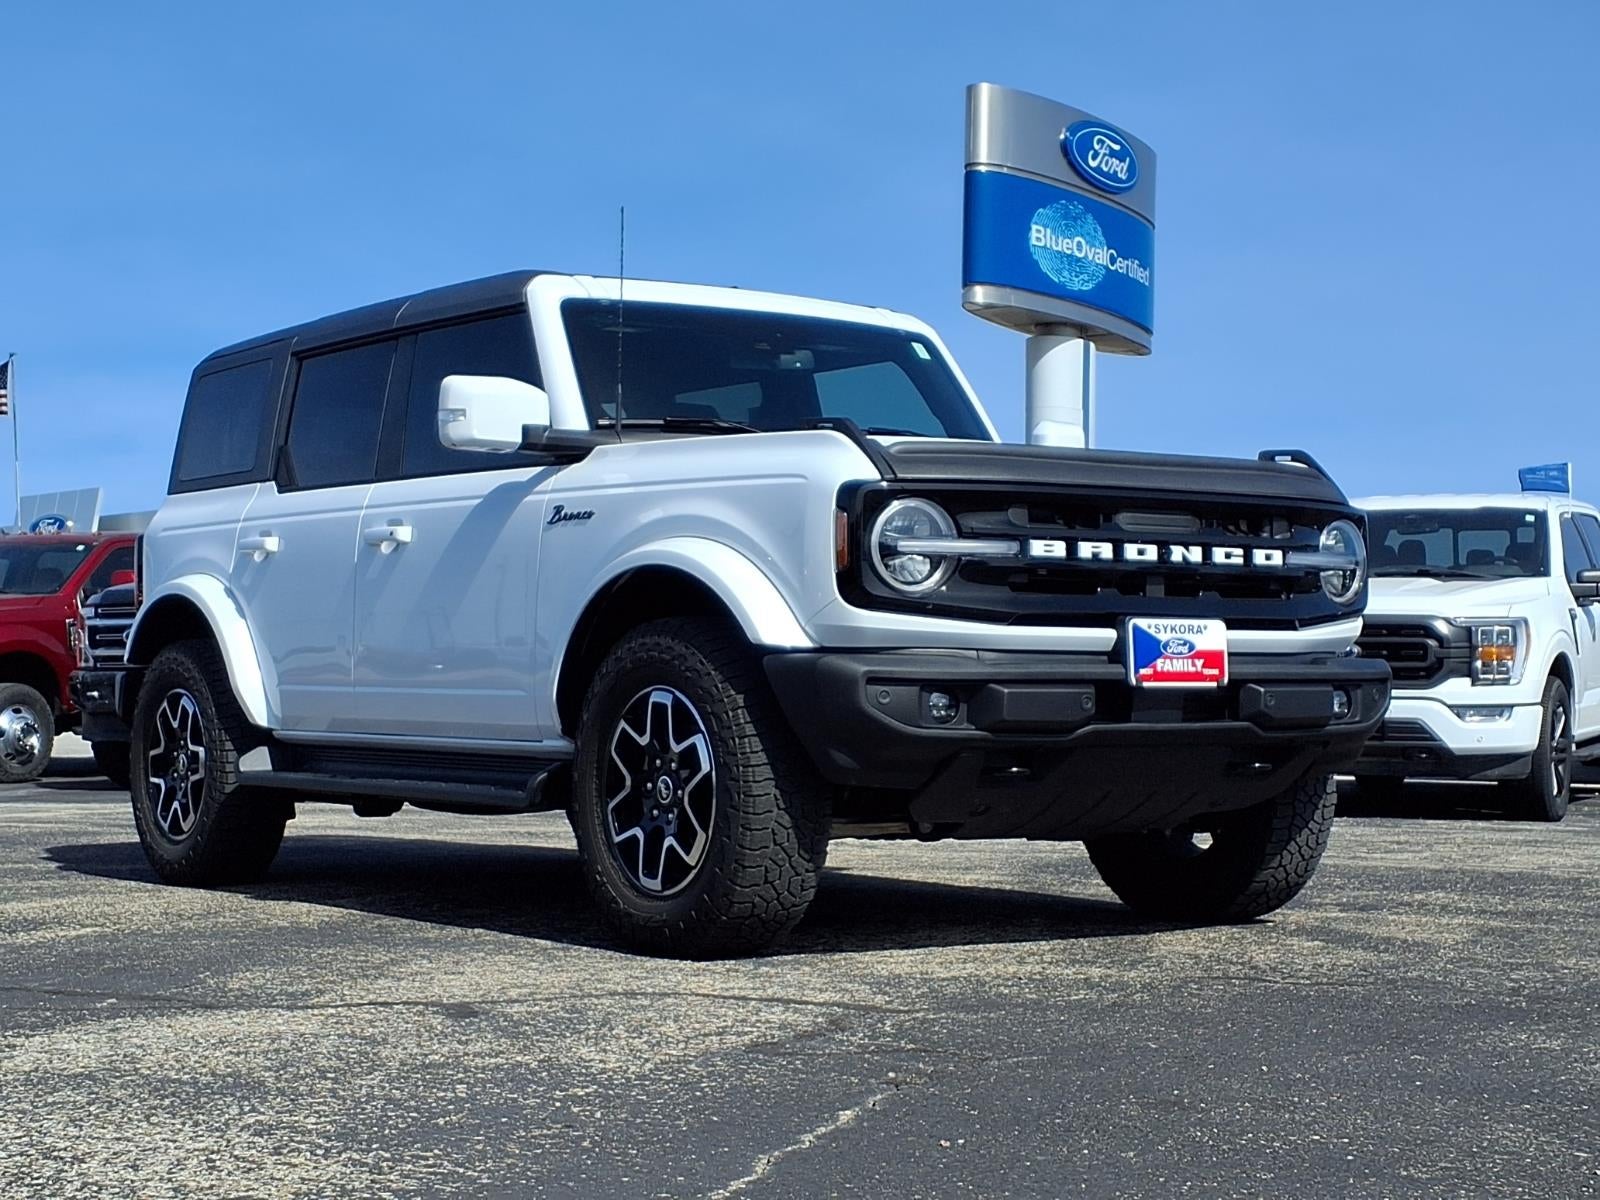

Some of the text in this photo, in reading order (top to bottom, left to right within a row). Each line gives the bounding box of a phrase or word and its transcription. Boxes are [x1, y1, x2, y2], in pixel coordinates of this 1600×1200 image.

[1088, 135, 1129, 179] Ford
[1030, 223, 1150, 287] BlueOvalCertified
[546, 504, 596, 525] Bronco
[1029, 540, 1283, 566] BRONCO
[1154, 623, 1204, 634] SYKORA
[1166, 639, 1190, 653] Ford
[1156, 659, 1205, 673] FAMILY
